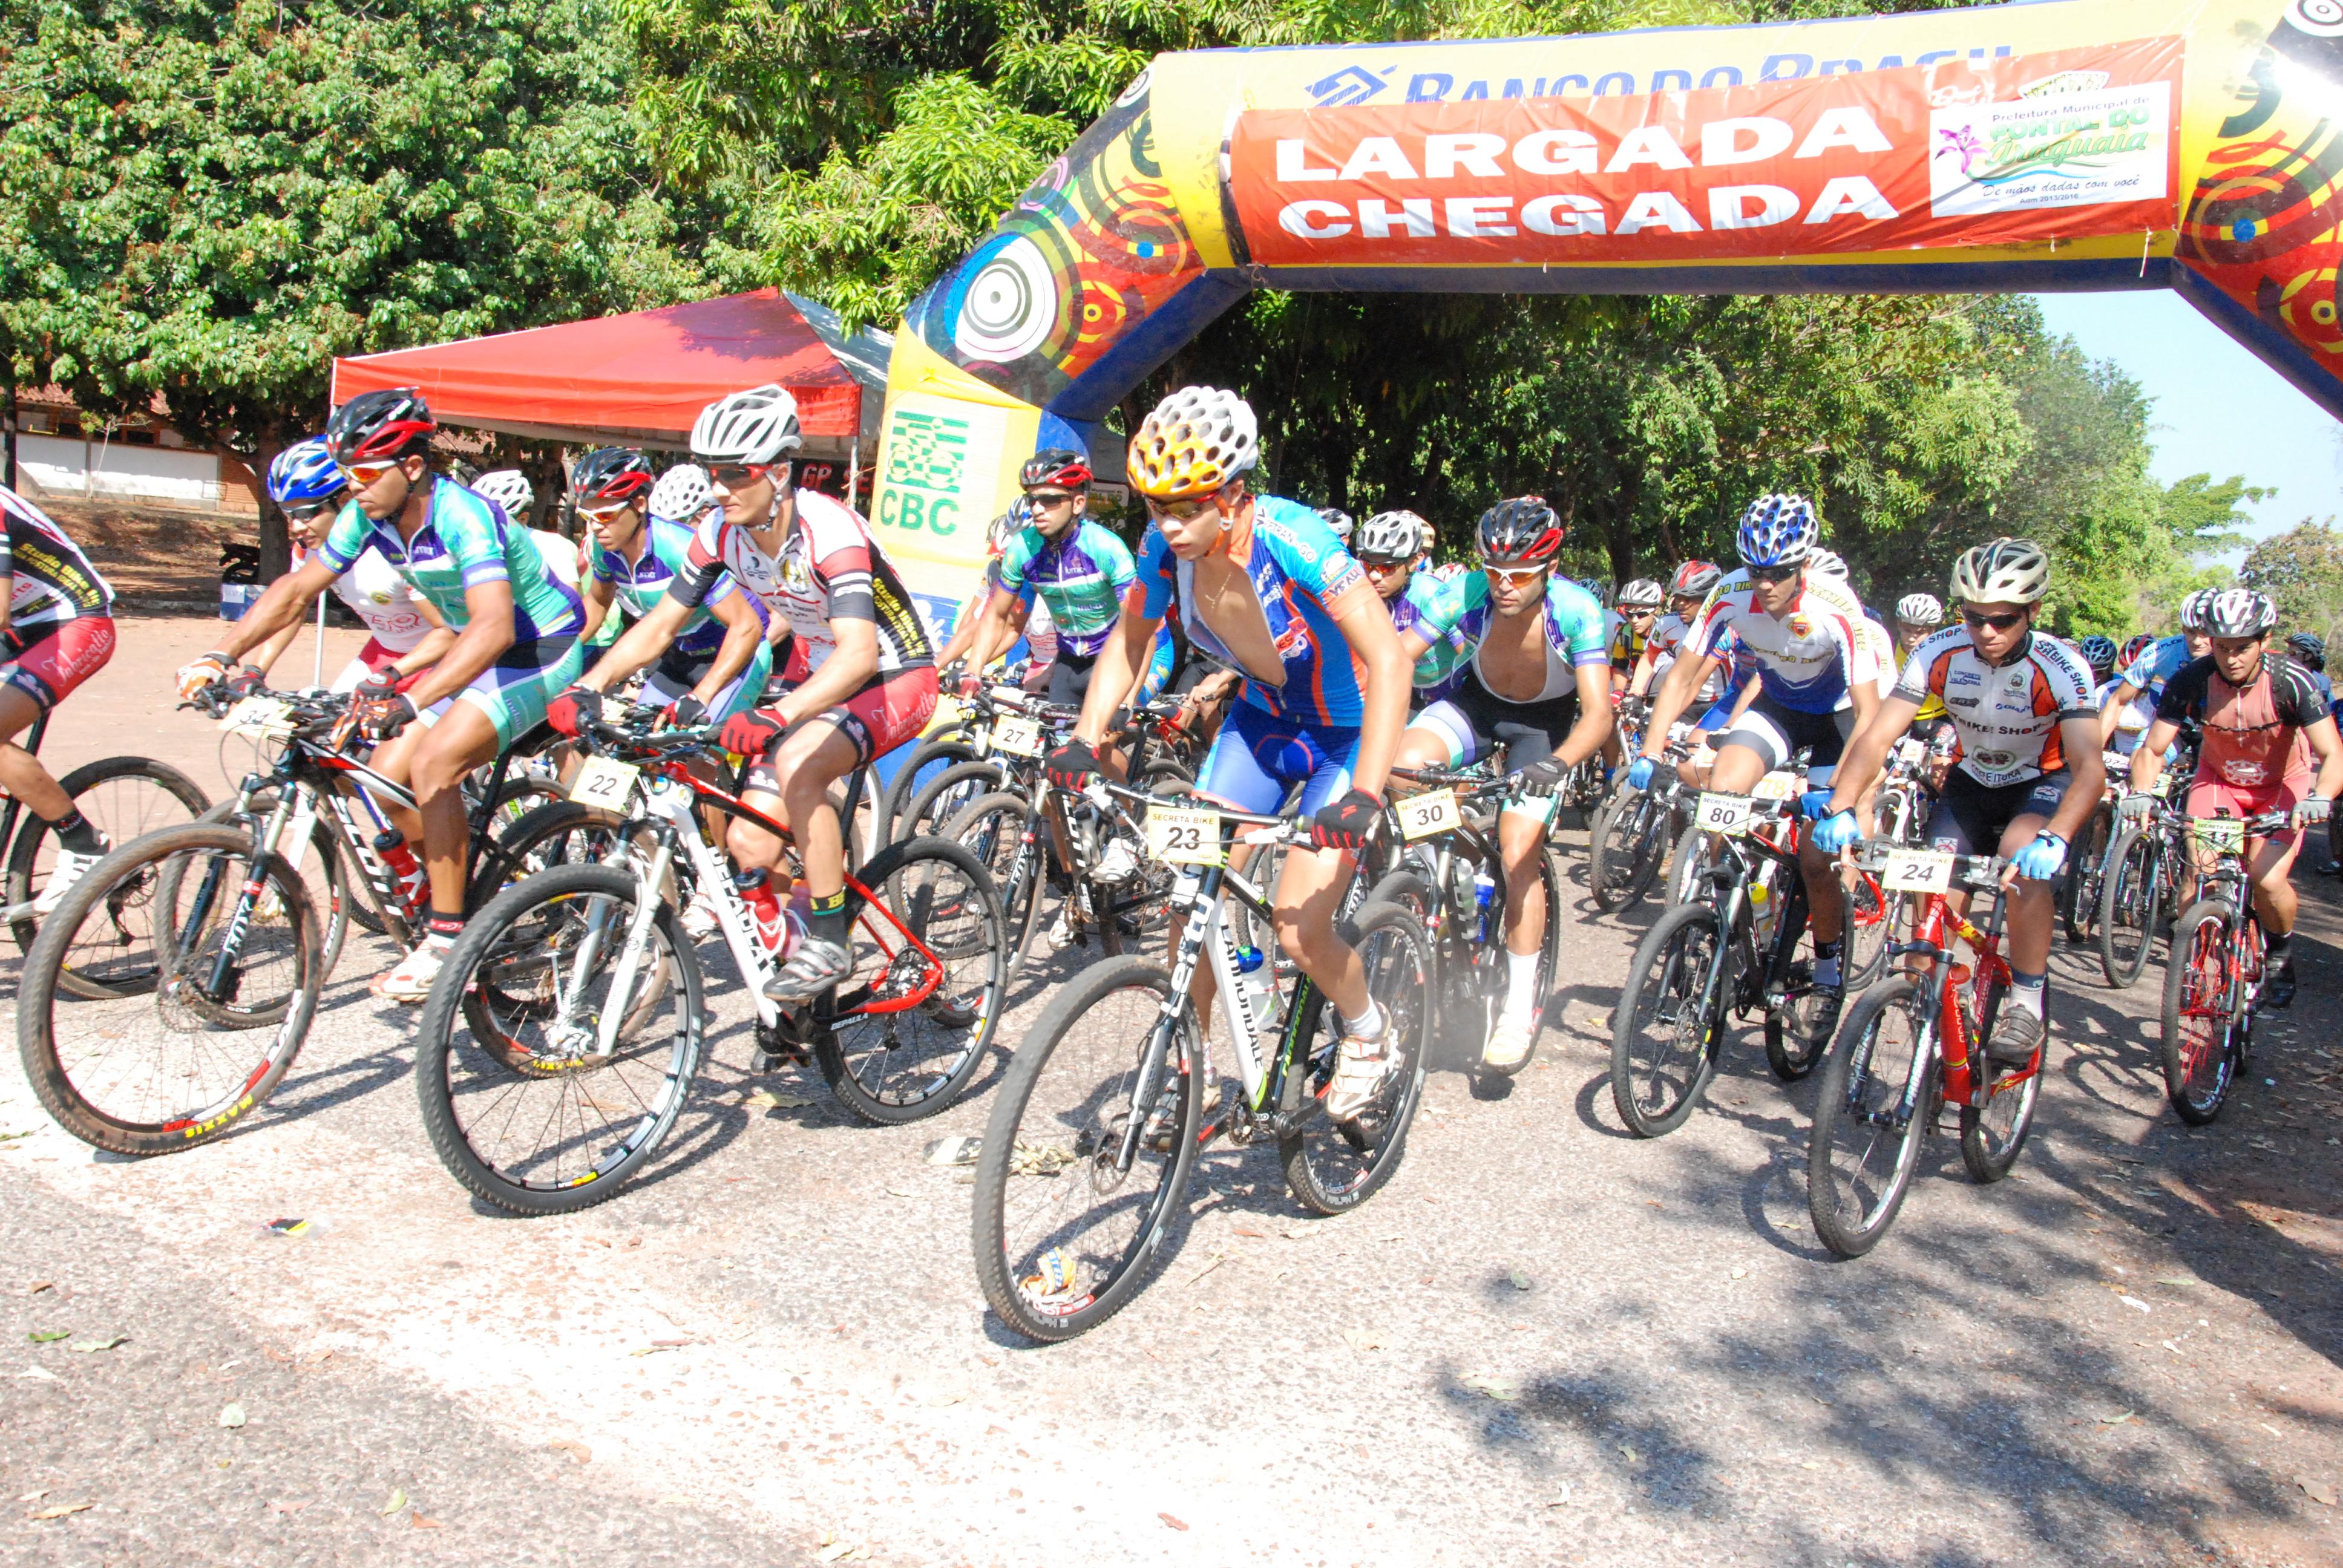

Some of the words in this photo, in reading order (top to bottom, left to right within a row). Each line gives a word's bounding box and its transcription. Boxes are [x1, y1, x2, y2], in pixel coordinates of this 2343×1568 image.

[1993, 108, 2057, 122] Prefeitura
[2063, 99, 2128, 113] Municipal
[2134, 96, 2150, 105] de
[1990, 114, 2099, 142] PONTAL
[2109, 106, 2150, 128] DO
[1276, 107, 1893, 181] LARGADA
[1986, 123, 2149, 168] Araguaia
[1982, 185, 2001, 197] De
[2005, 181, 2036, 195] mãos
[2042, 178, 2080, 192] dadas
[2085, 180, 2108, 189] com
[2114, 174, 2140, 186] você
[1279, 175, 1899, 238] CHEGADA
[2039, 193, 2079, 203] 2013/2016
[801, 463, 832, 488] GP
[880, 488, 960, 536] CBC
[1300, 544, 1315, 561] GO
[18, 543, 61, 569] Studio
[60, 564, 90, 590] Bike
[873, 577, 902, 612] Studio
[1734, 581, 1752, 592] BIK
[1806, 582, 1856, 618] LEANDRO
[1928, 627, 1961, 644] SHOP
[2050, 649, 2073, 674] BIKE
[2069, 672, 2090, 701] SHOP
[240, 710, 270, 725] 34
[1003, 728, 1026, 745] 27
[1998, 724, 2041, 735] SHOP
[587, 774, 618, 797] 22
[1761, 778, 1786, 797] 78
[1400, 799, 1432, 811] SECRETA
[1433, 793, 1450, 803] BIKE
[1703, 797, 1730, 806] SECRETA
[1153, 813, 1190, 824] SECRETA
[1193, 817, 1215, 825] BIKE
[1417, 805, 1444, 826] 30
[1709, 807, 1735, 825] 80
[1167, 826, 1201, 851] 23
[1010, 843, 1029, 886] FOX
[1901, 863, 1935, 882] 24
[222, 897, 254, 958] FOX
[184, 1094, 253, 1138] MAXXIS
